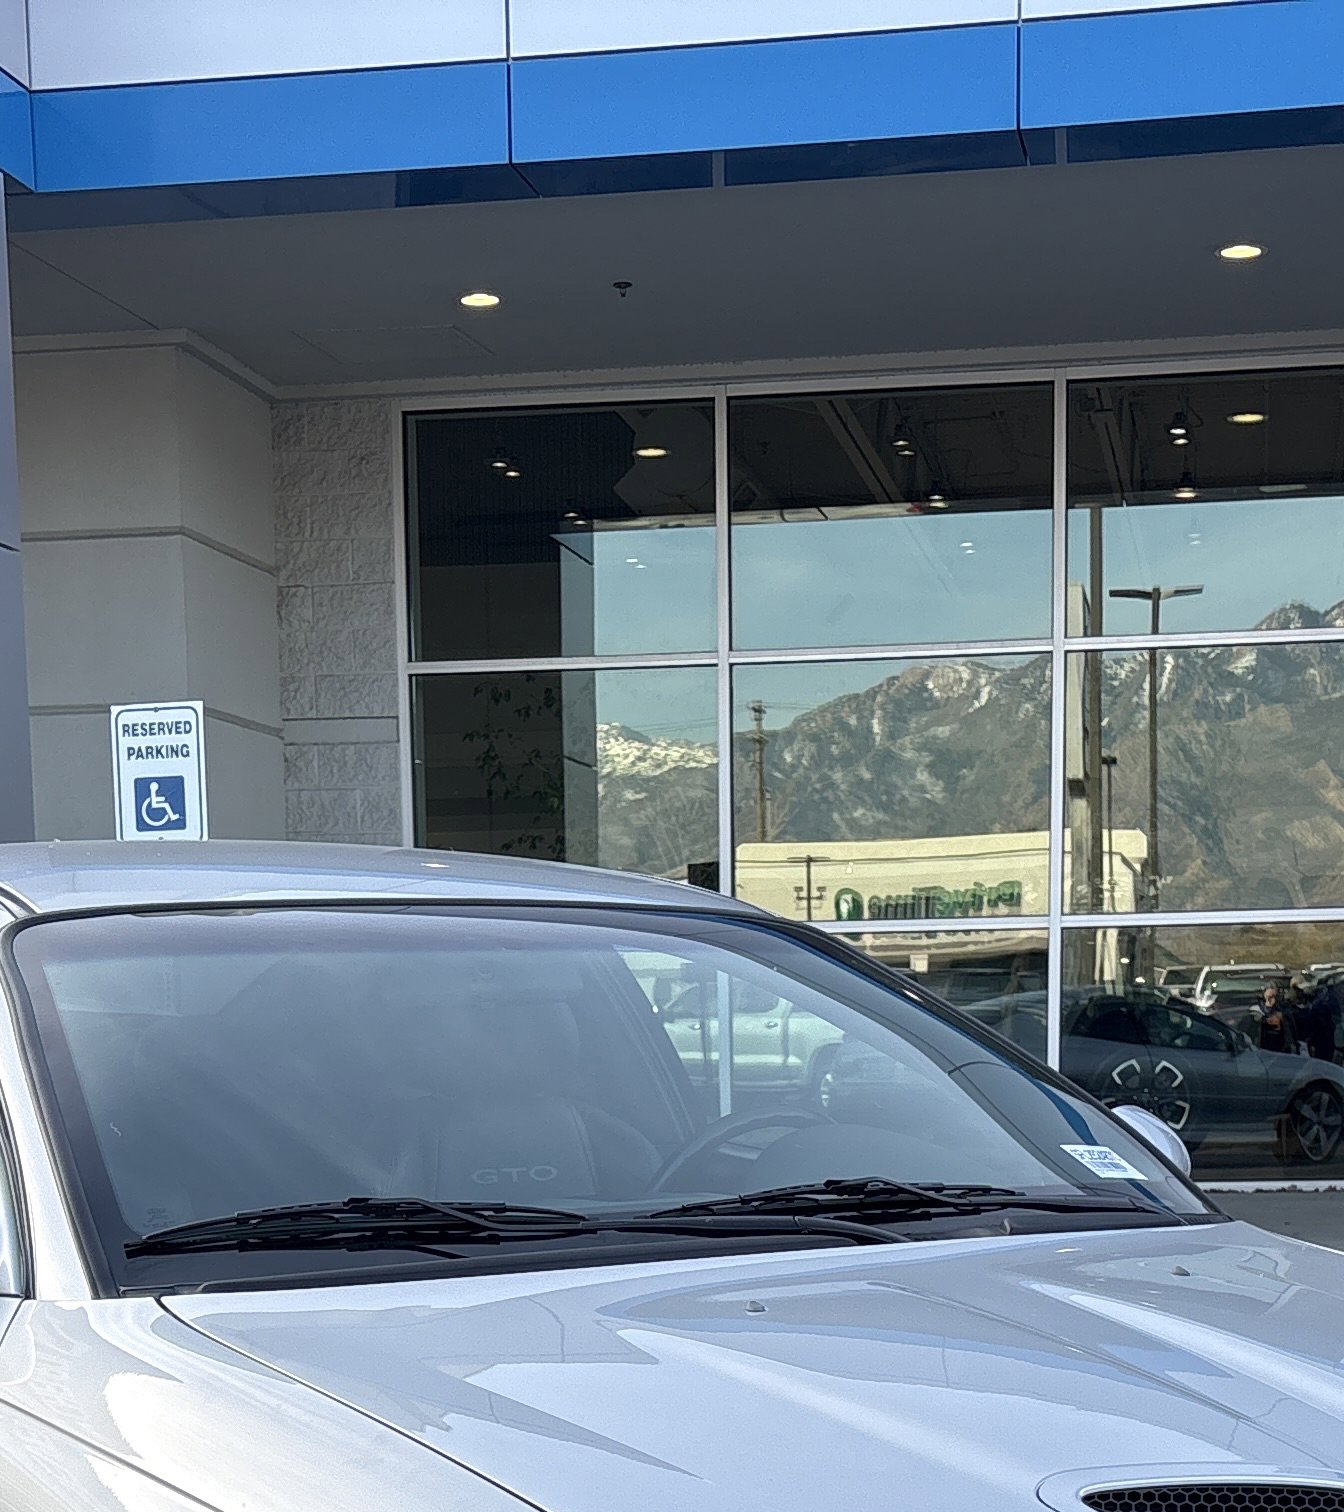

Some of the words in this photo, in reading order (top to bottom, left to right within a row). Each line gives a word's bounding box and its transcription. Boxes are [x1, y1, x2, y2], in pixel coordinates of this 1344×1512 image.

[122, 720, 192, 737] RESERVED
[127, 744, 190, 760] PARKING
[471, 1165, 557, 1184] GTO
